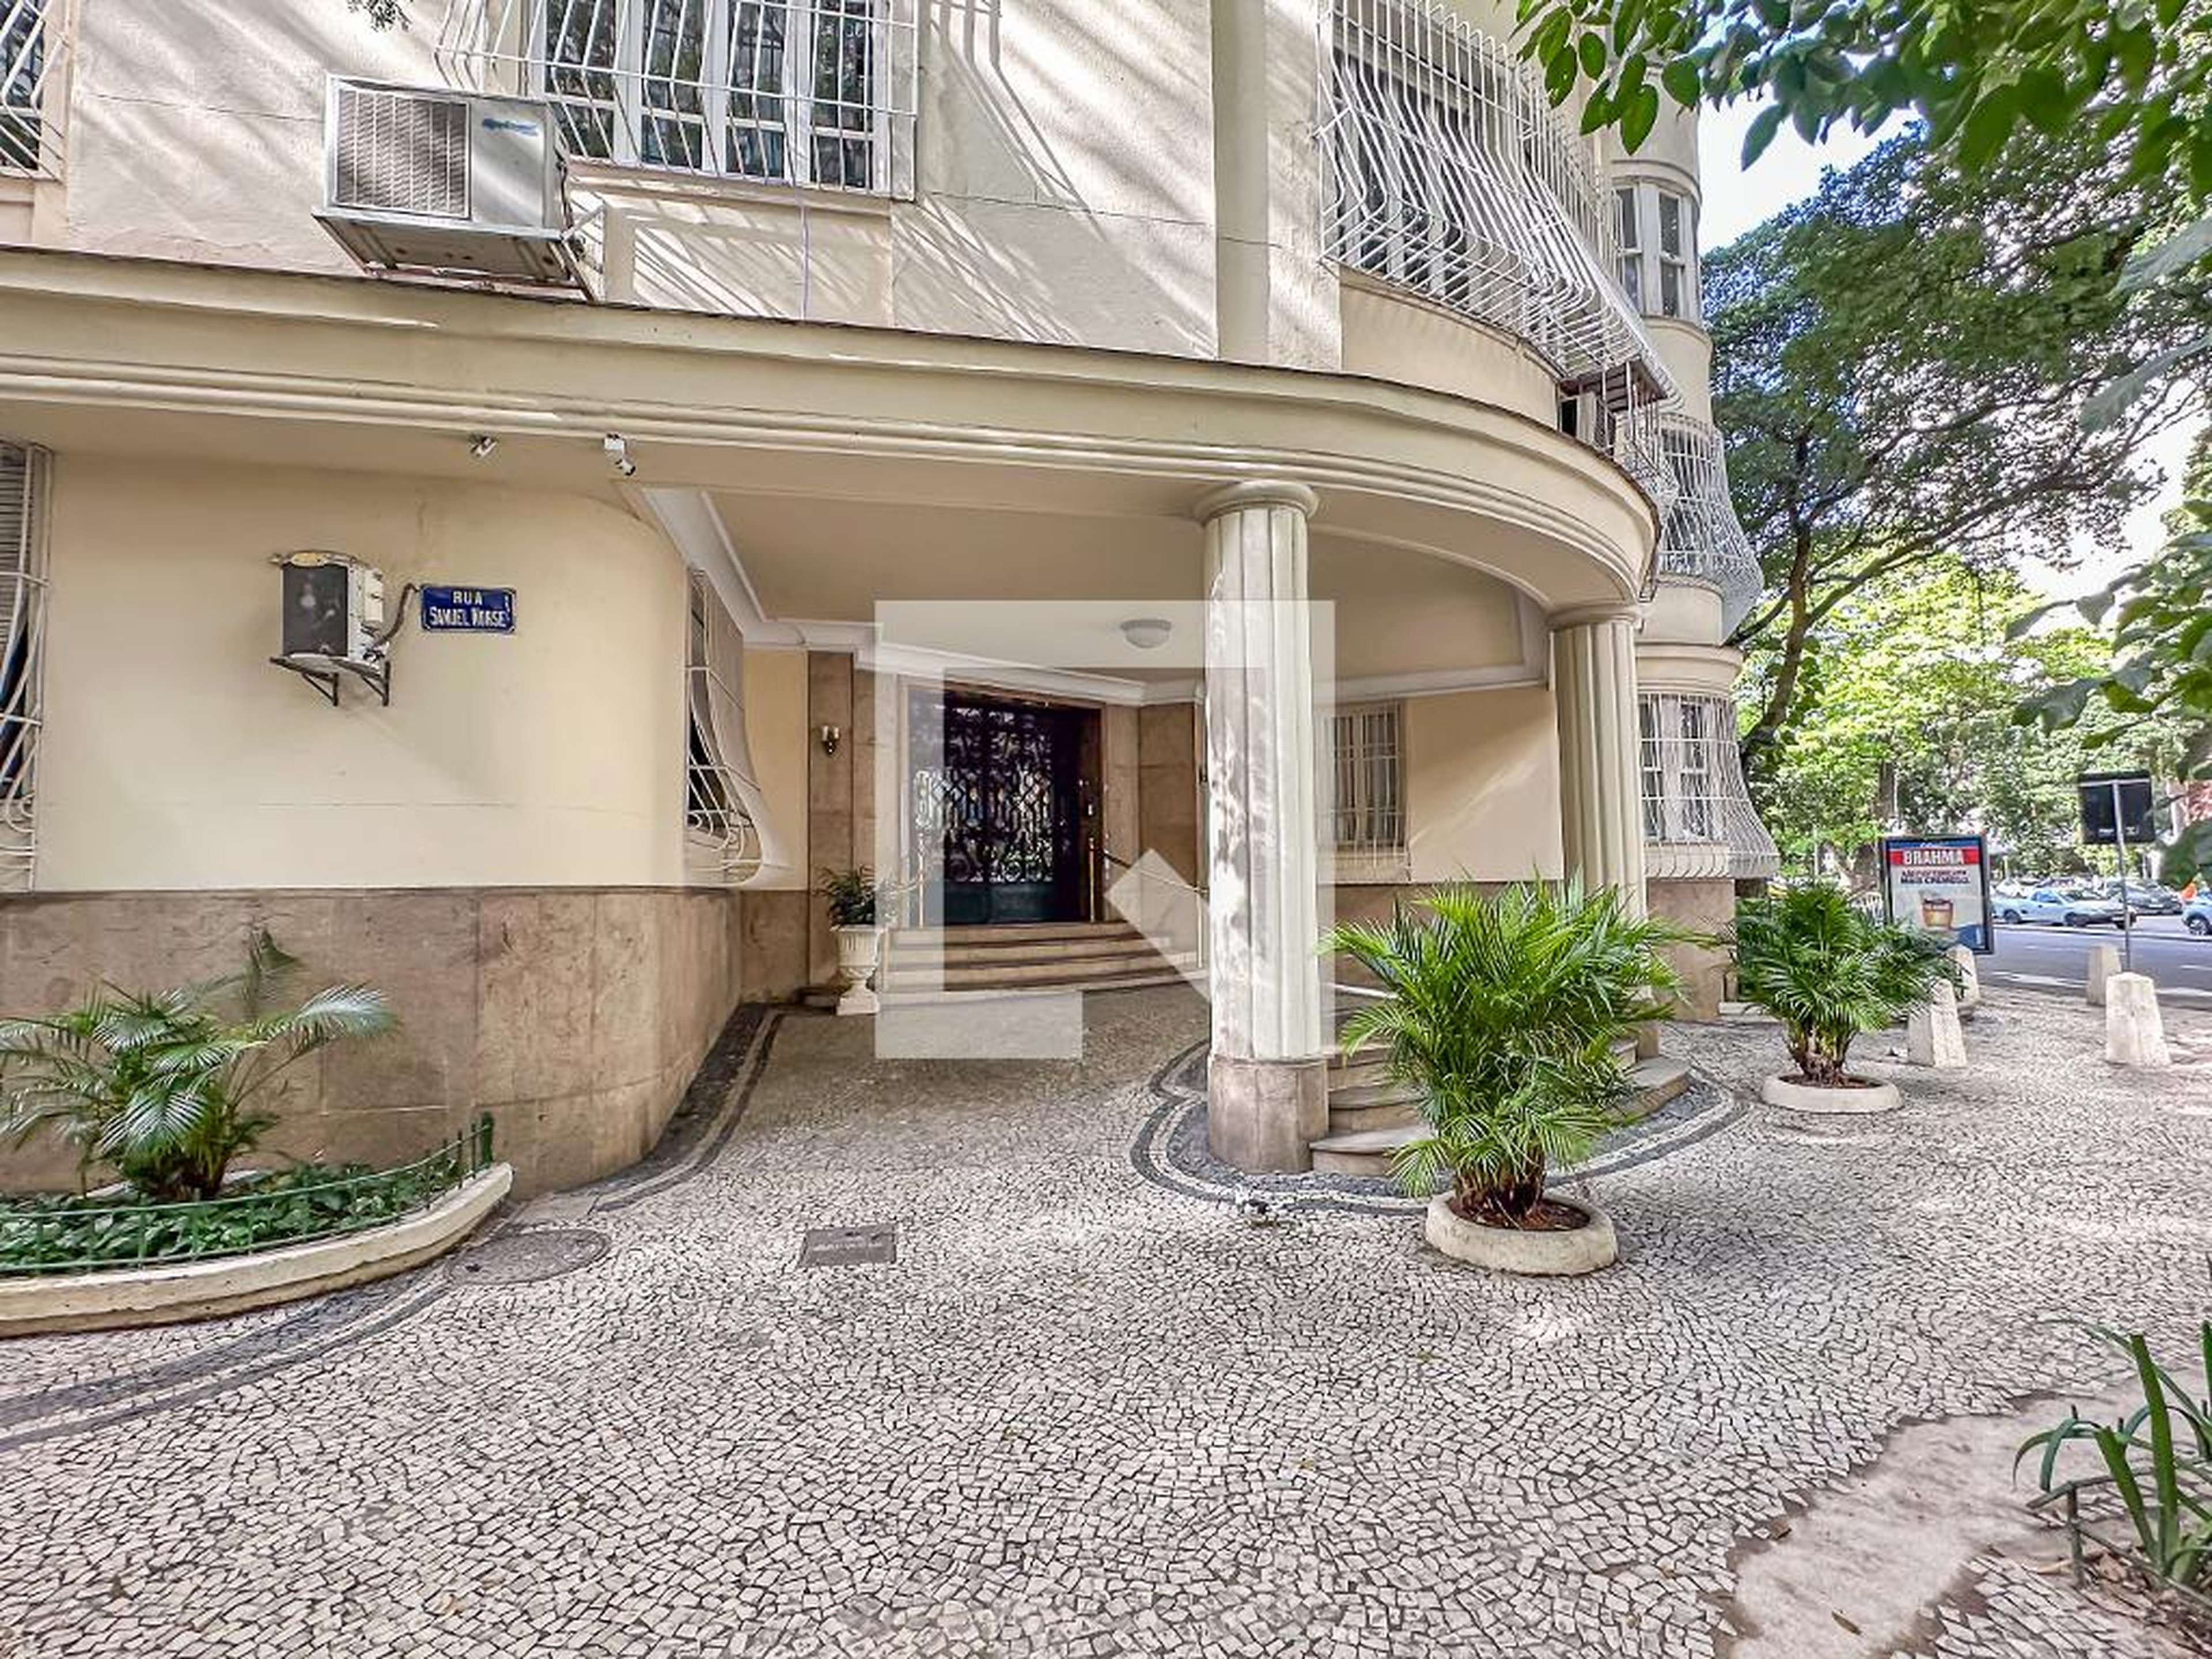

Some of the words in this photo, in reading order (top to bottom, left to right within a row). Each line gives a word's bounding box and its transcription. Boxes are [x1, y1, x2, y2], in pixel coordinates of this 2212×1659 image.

[453, 590, 483, 605] RUA
[430, 607, 471, 627] SAMUEL
[1903, 850, 1964, 865] BRAHMA
